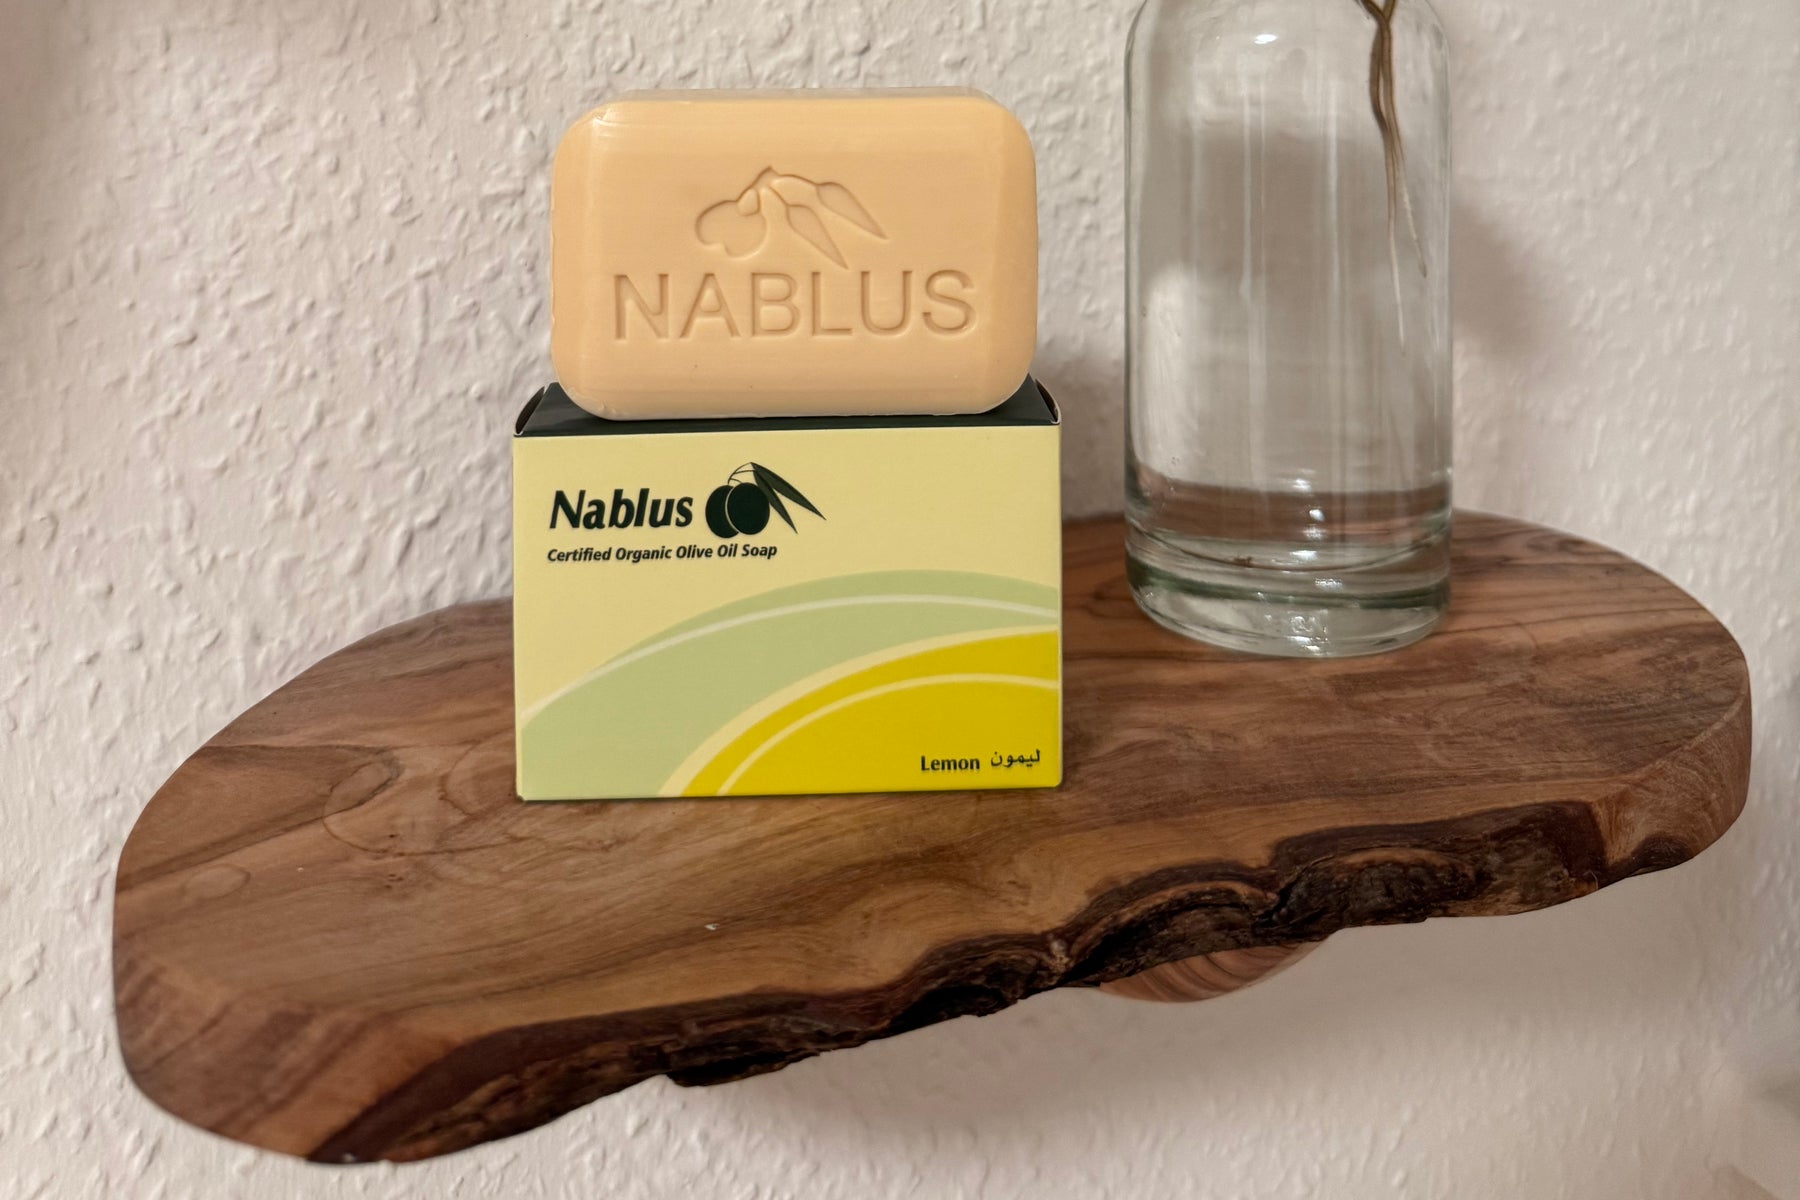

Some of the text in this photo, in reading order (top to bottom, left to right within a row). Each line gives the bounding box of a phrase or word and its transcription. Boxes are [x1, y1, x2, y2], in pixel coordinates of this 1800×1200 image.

[613, 269, 977, 340] NABLUS
[549, 488, 694, 530] Nablus
[547, 542, 778, 563] Certified Organic Olive Oil Soap
[921, 755, 981, 772] Lemon
[990, 748, 1041, 768] ليمون
